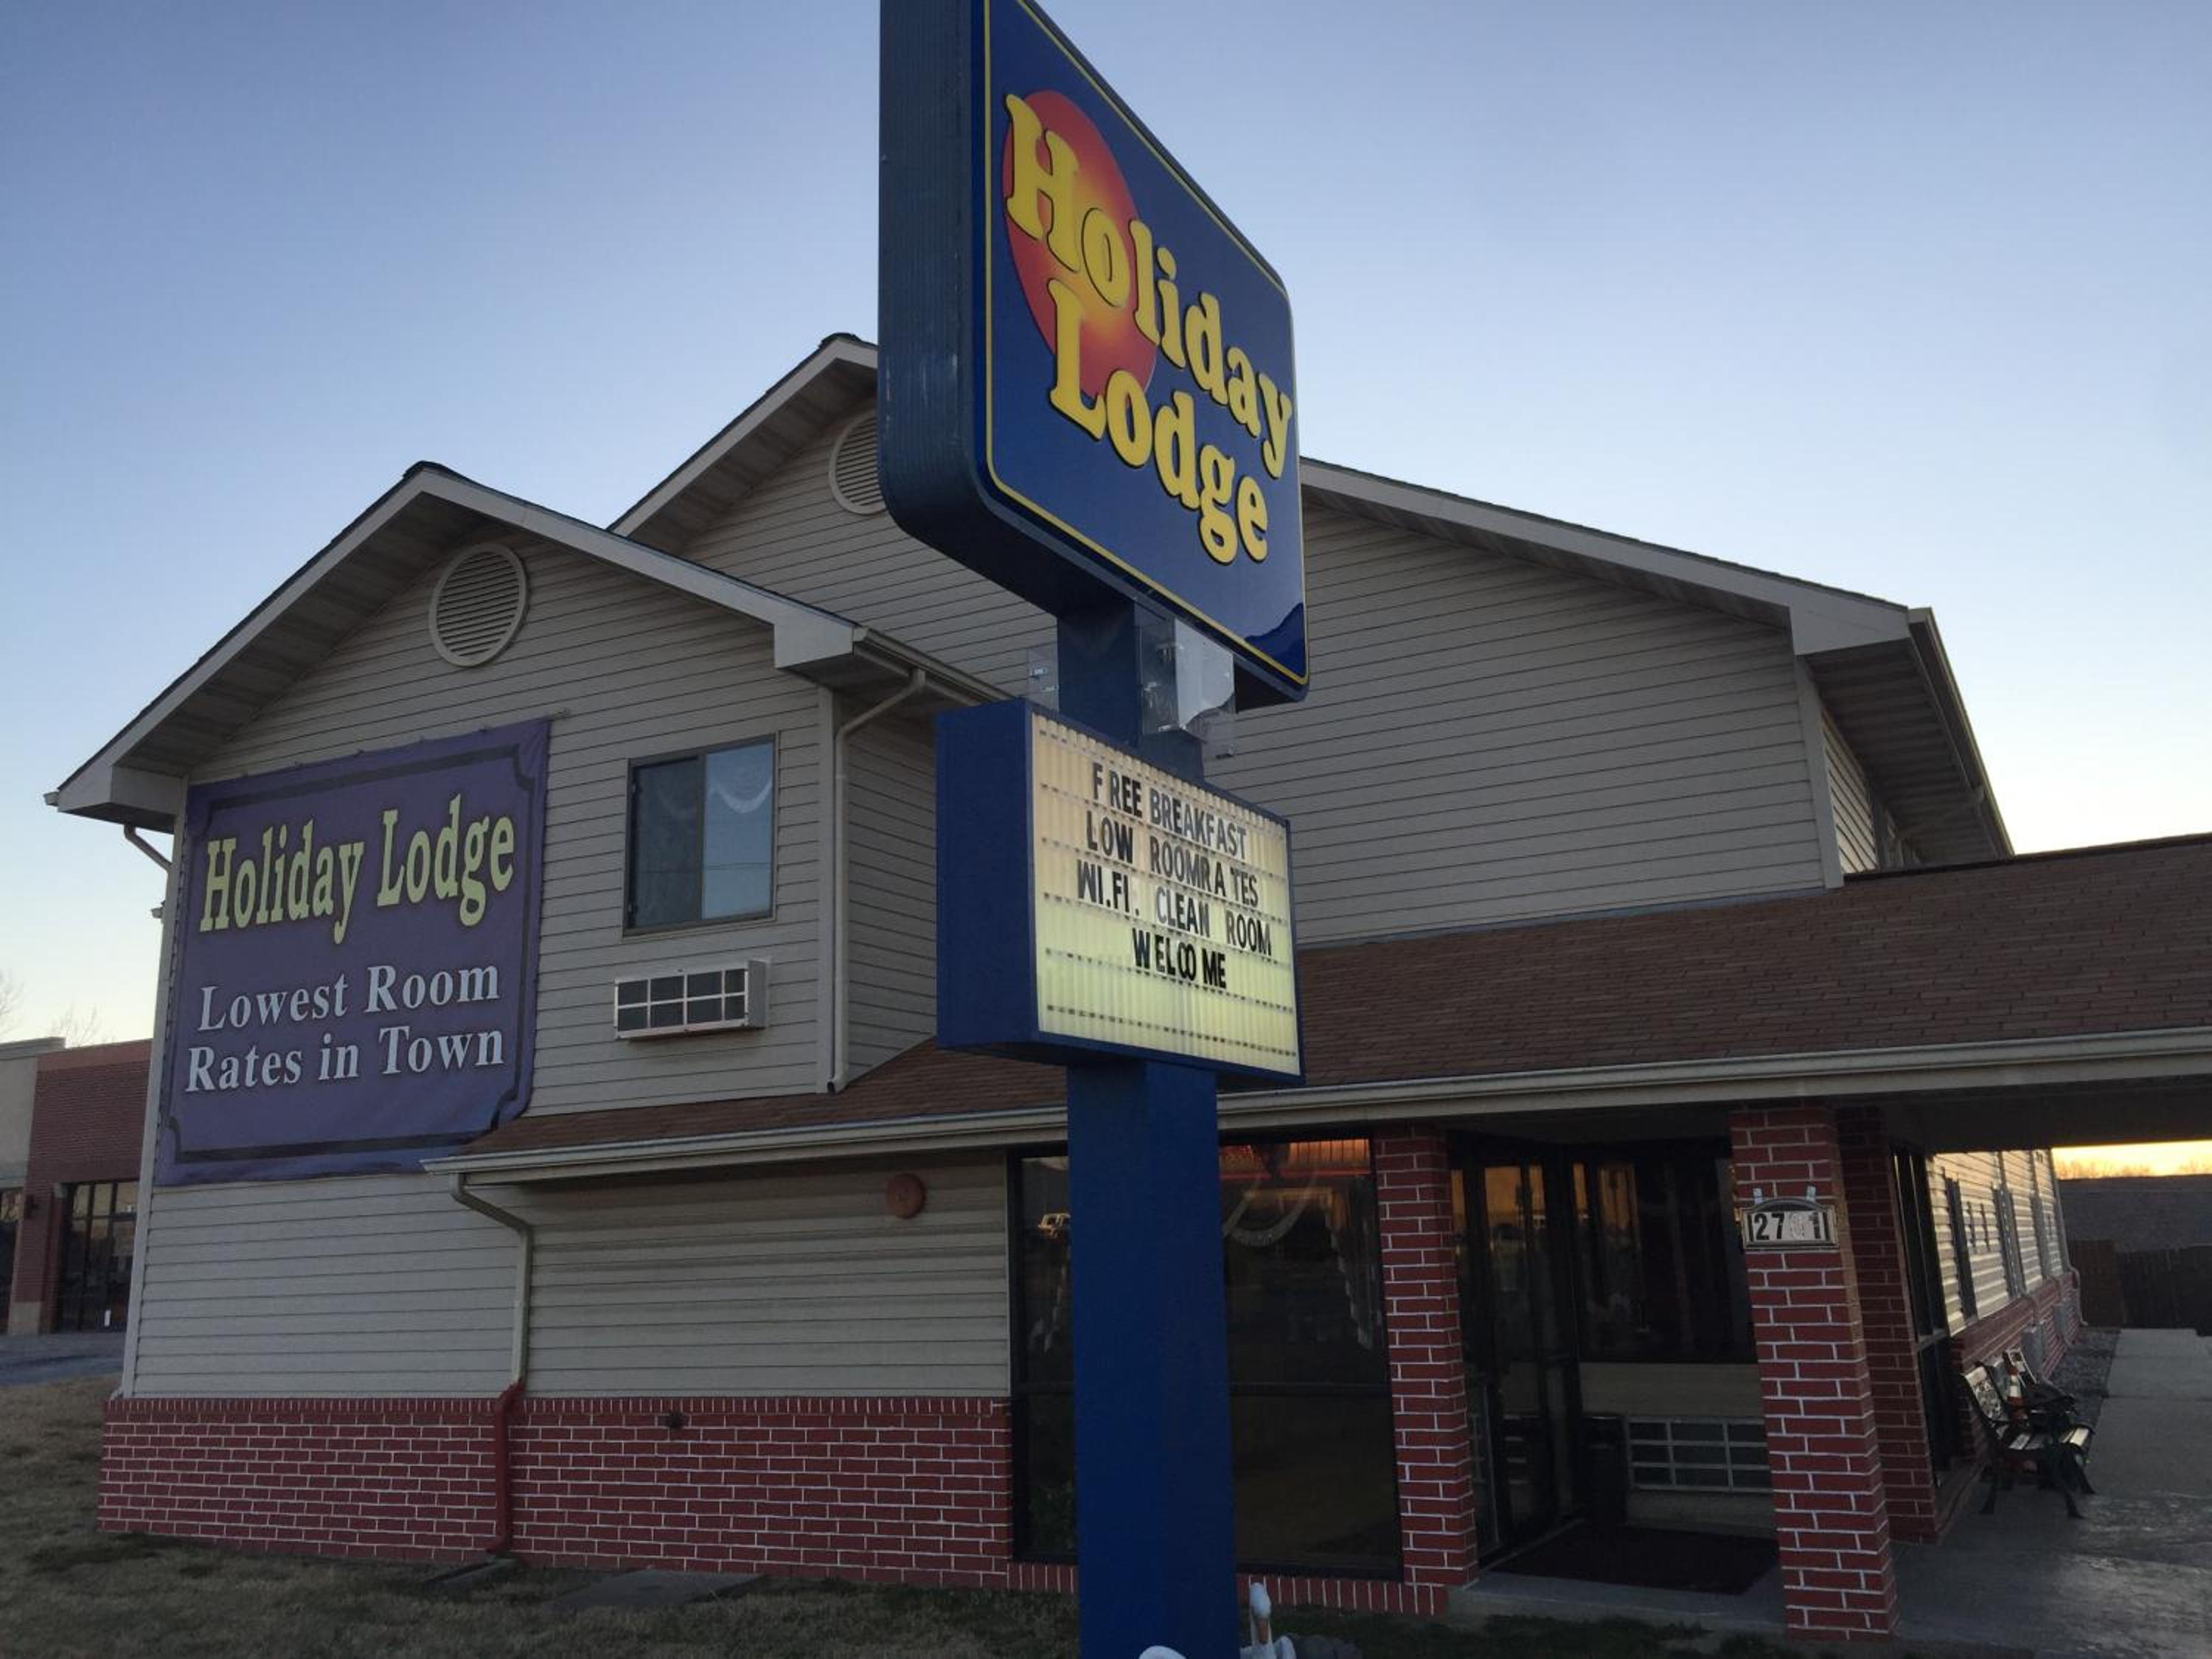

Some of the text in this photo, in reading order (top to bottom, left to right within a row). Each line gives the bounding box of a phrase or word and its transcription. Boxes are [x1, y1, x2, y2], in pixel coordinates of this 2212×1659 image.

[1006, 94, 1292, 479] Holiday
[1048, 279, 1268, 563] Lodge
[1087, 811, 1133, 863] LOW
[1092, 762, 1248, 860] FREE BREAKFAST
[200, 793, 515, 945] Holiday Lodge
[1155, 886, 1210, 938] CLEAN
[1225, 909, 1272, 956] ROOM
[1133, 927, 1227, 989] WELCOME
[198, 963, 500, 1032] Lowest Room
[185, 1026, 504, 1092] Rates in Town
